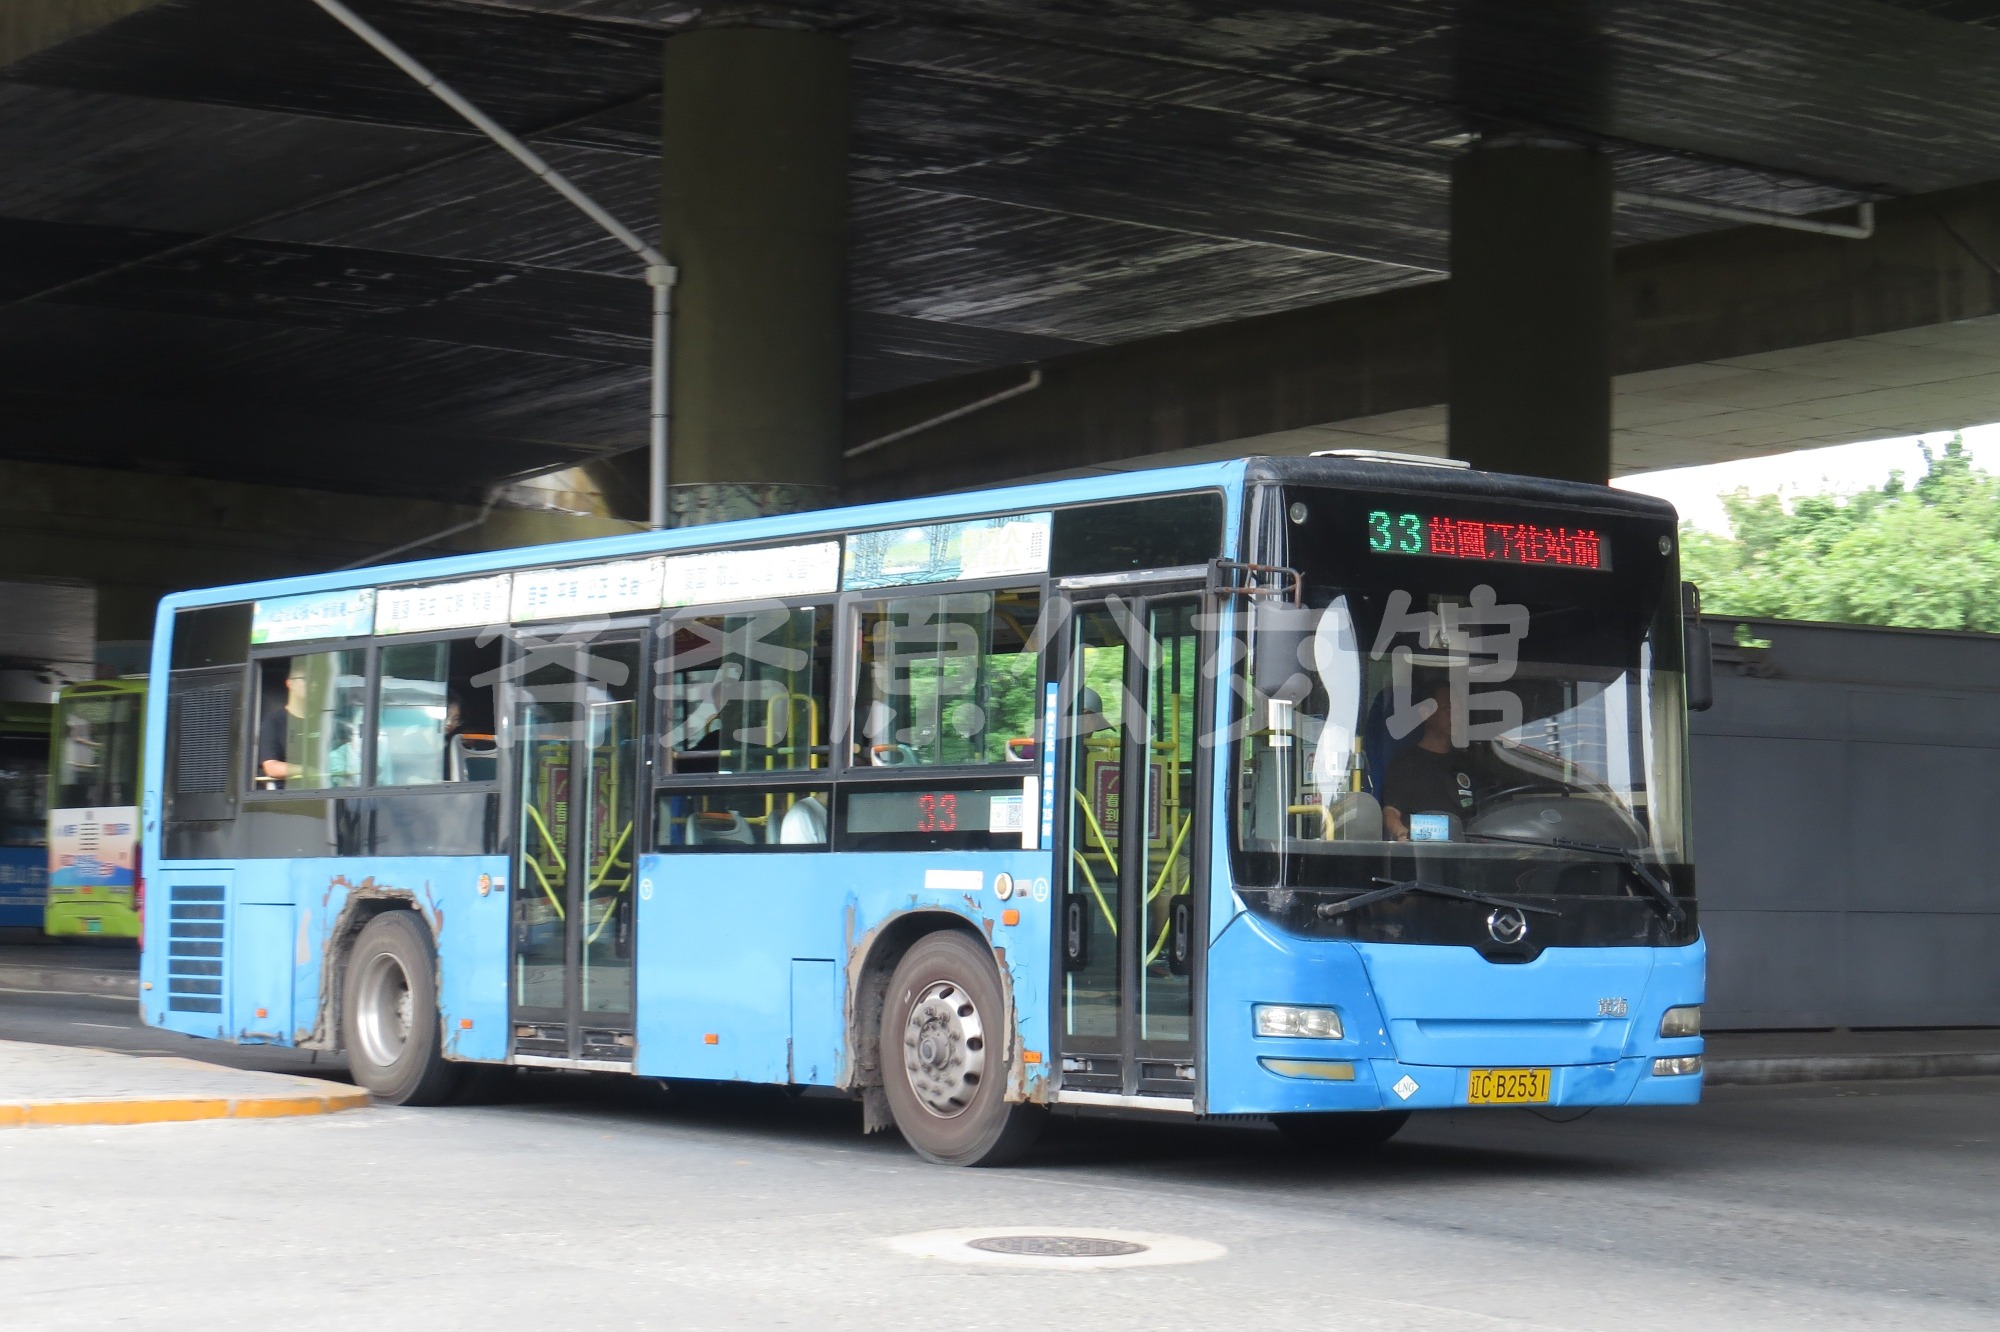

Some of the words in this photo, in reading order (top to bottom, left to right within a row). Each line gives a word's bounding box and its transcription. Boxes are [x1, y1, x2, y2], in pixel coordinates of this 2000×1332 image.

[1369, 511, 1422, 554] 33
[918, 793, 957, 832] 33
[1397, 1082, 1415, 1093] LNG
